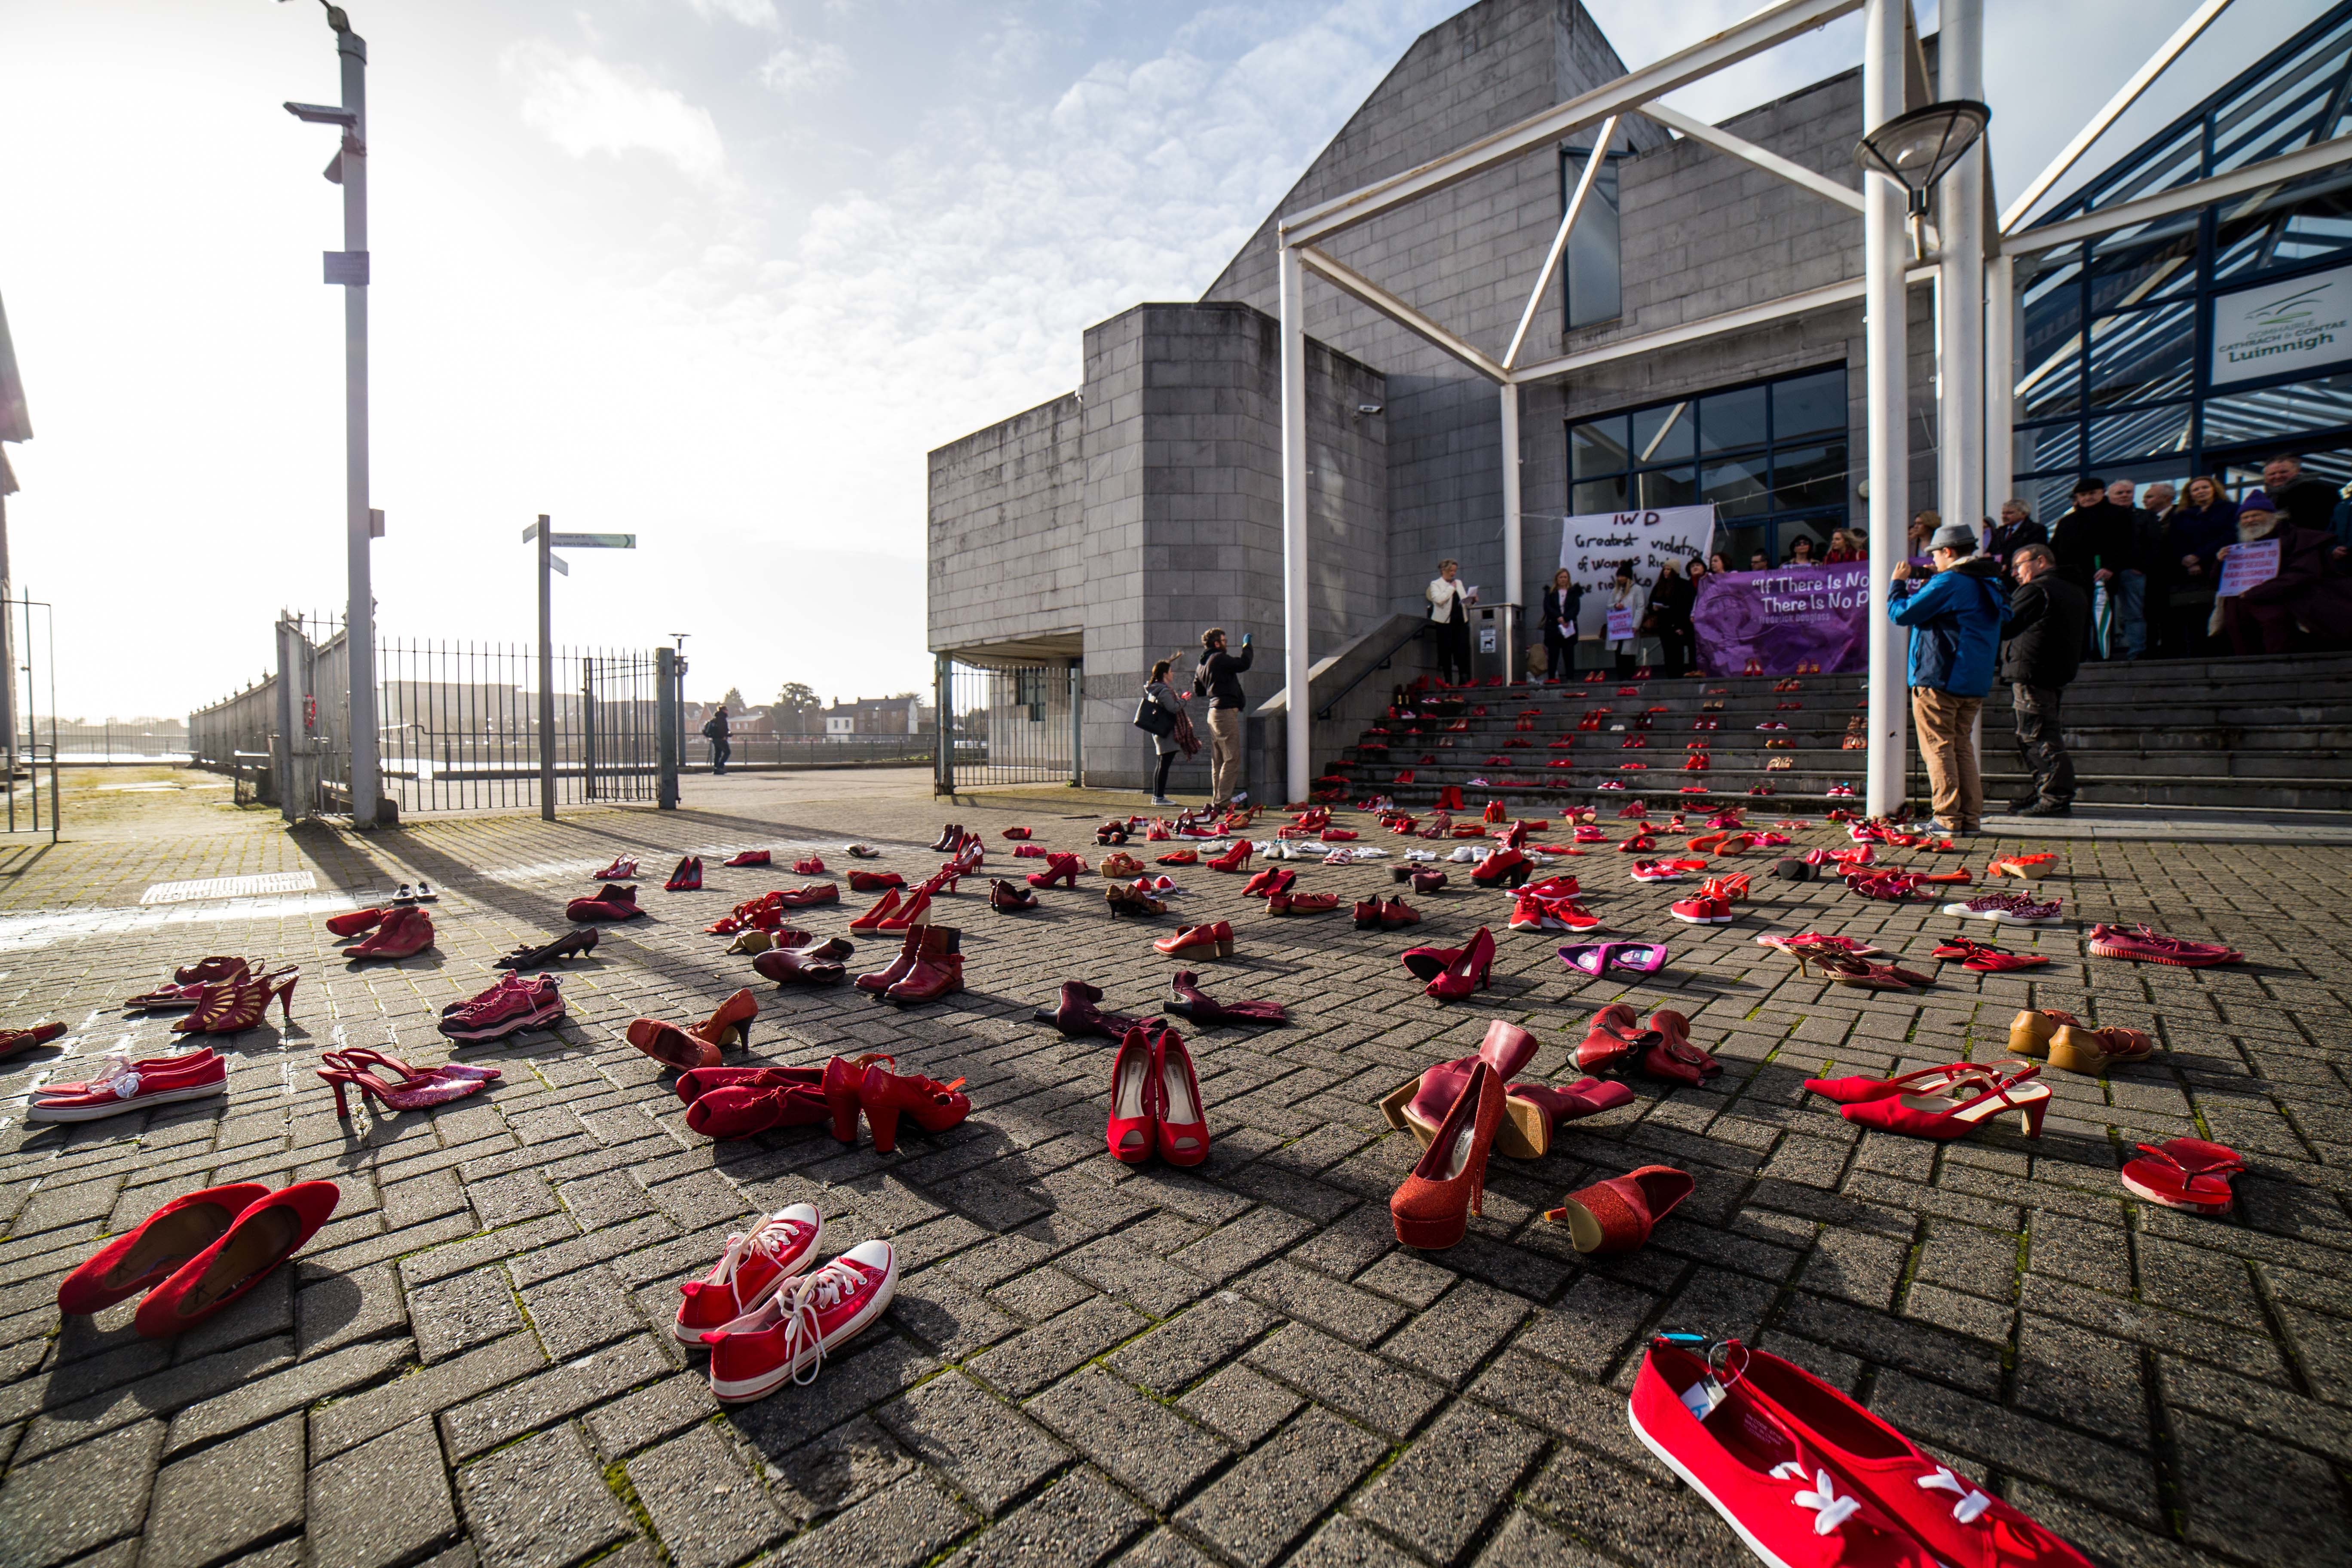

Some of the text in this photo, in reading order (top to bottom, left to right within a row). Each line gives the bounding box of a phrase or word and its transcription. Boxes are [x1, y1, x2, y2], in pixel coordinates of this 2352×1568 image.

[2218, 334, 2281, 352] CATHRACH
[2294, 319, 2347, 337] CONTAE
[2229, 334, 2334, 363] Luimnigh
[1575, 532, 1639, 548] Greatest
[1577, 555, 1588, 572] of
[1776, 576, 1823, 593] There
[1827, 574, 1841, 590] Is
[1845, 571, 1869, 587] No
[1761, 597, 1807, 613] There
[1810, 594, 1825, 609] Is
[1828, 592, 1852, 609] No
[1455, 1122, 1472, 1155] COUTURE
